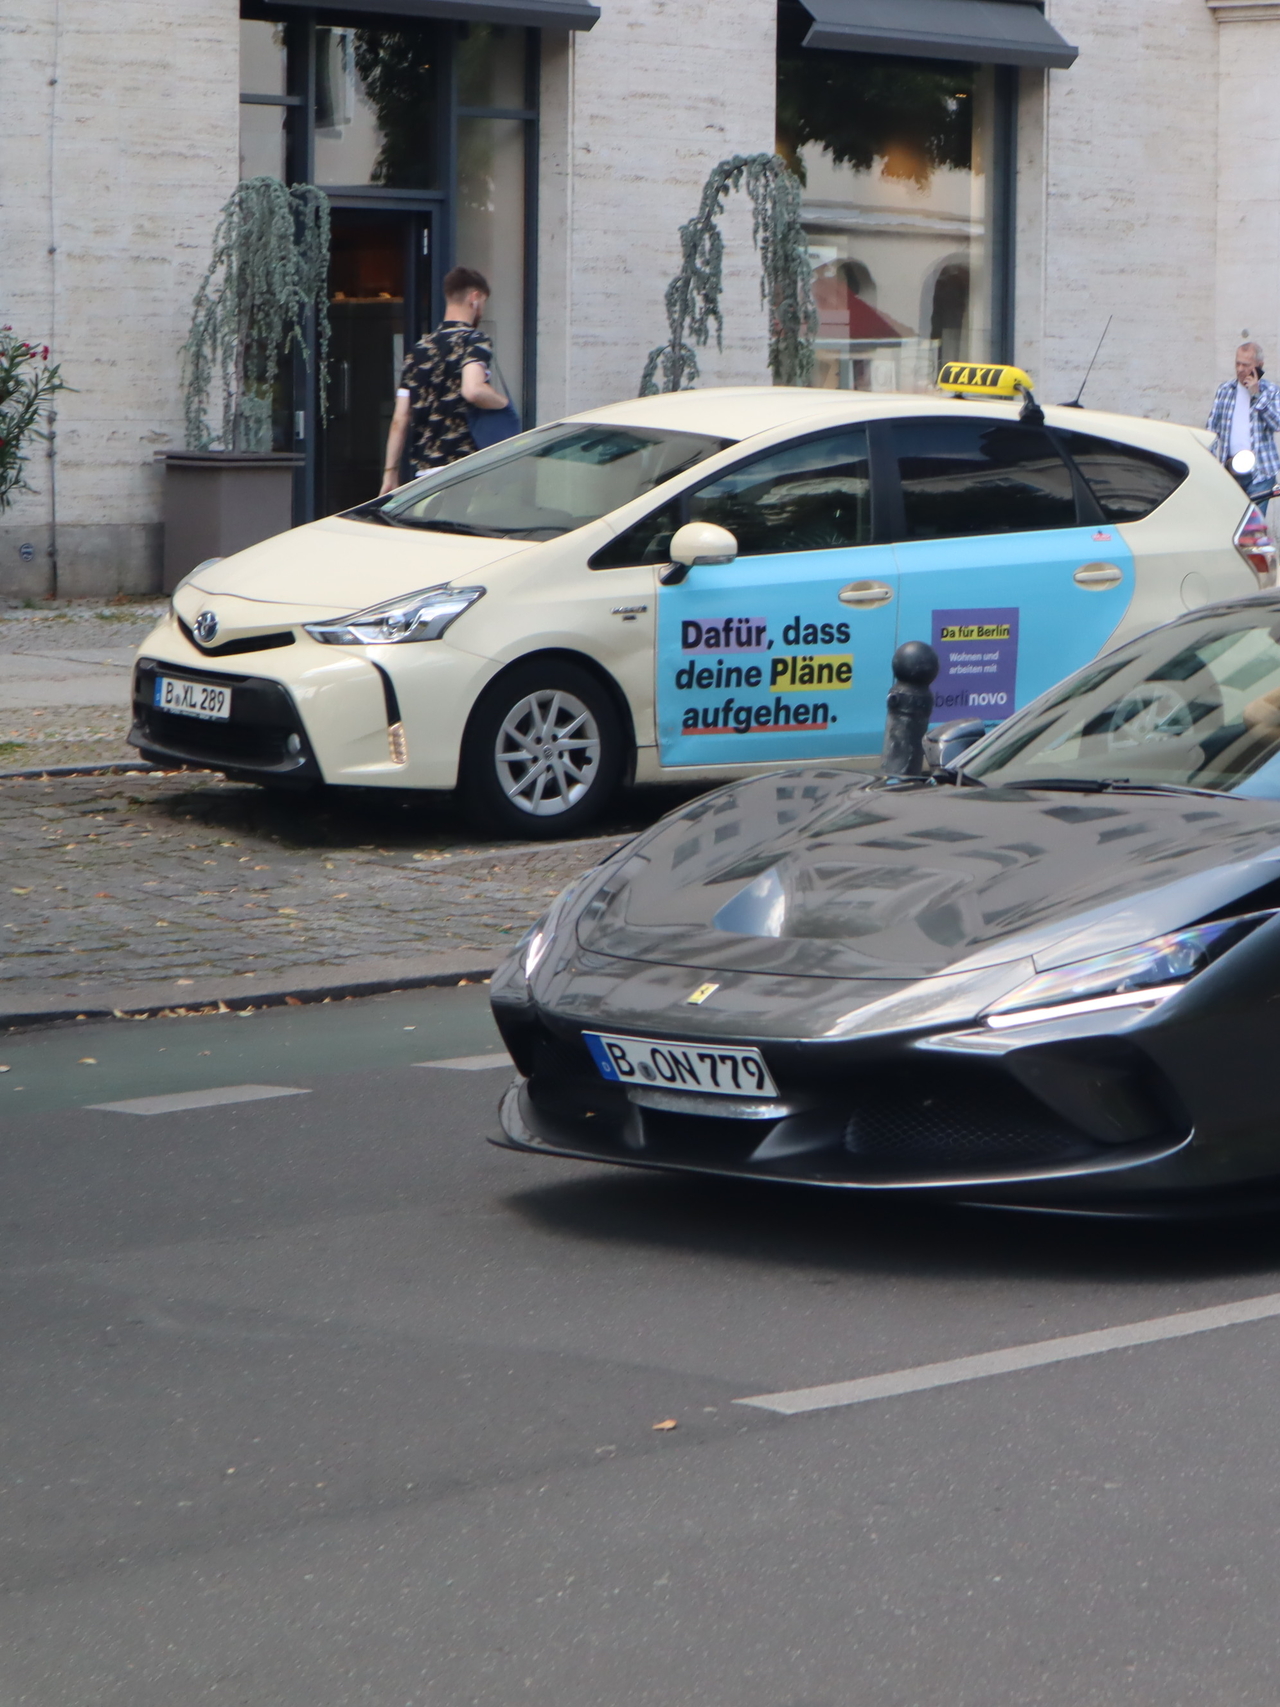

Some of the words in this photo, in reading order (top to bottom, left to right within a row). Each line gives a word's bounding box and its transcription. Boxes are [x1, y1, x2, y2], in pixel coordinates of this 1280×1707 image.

[949, 367, 995, 386] TAXI
[681, 617, 775, 650] Dafür,
[782, 615, 851, 646] dass
[941, 627, 956, 639] Da
[958, 625, 974, 638] für
[977, 623, 1010, 638] Berlin
[949, 652, 982, 662] Wohnen
[983, 650, 999, 661] und
[675, 658, 763, 690] deine
[769, 656, 853, 686] Pläne
[949, 664, 982, 675] arbeiten
[165, 683, 173, 703] B
[181, 685, 196, 708] XL
[200, 688, 224, 713] 289
[934, 690, 1007, 708] berlinovo
[681, 696, 838, 734] aufgehen.
[605, 1042, 635, 1076] B
